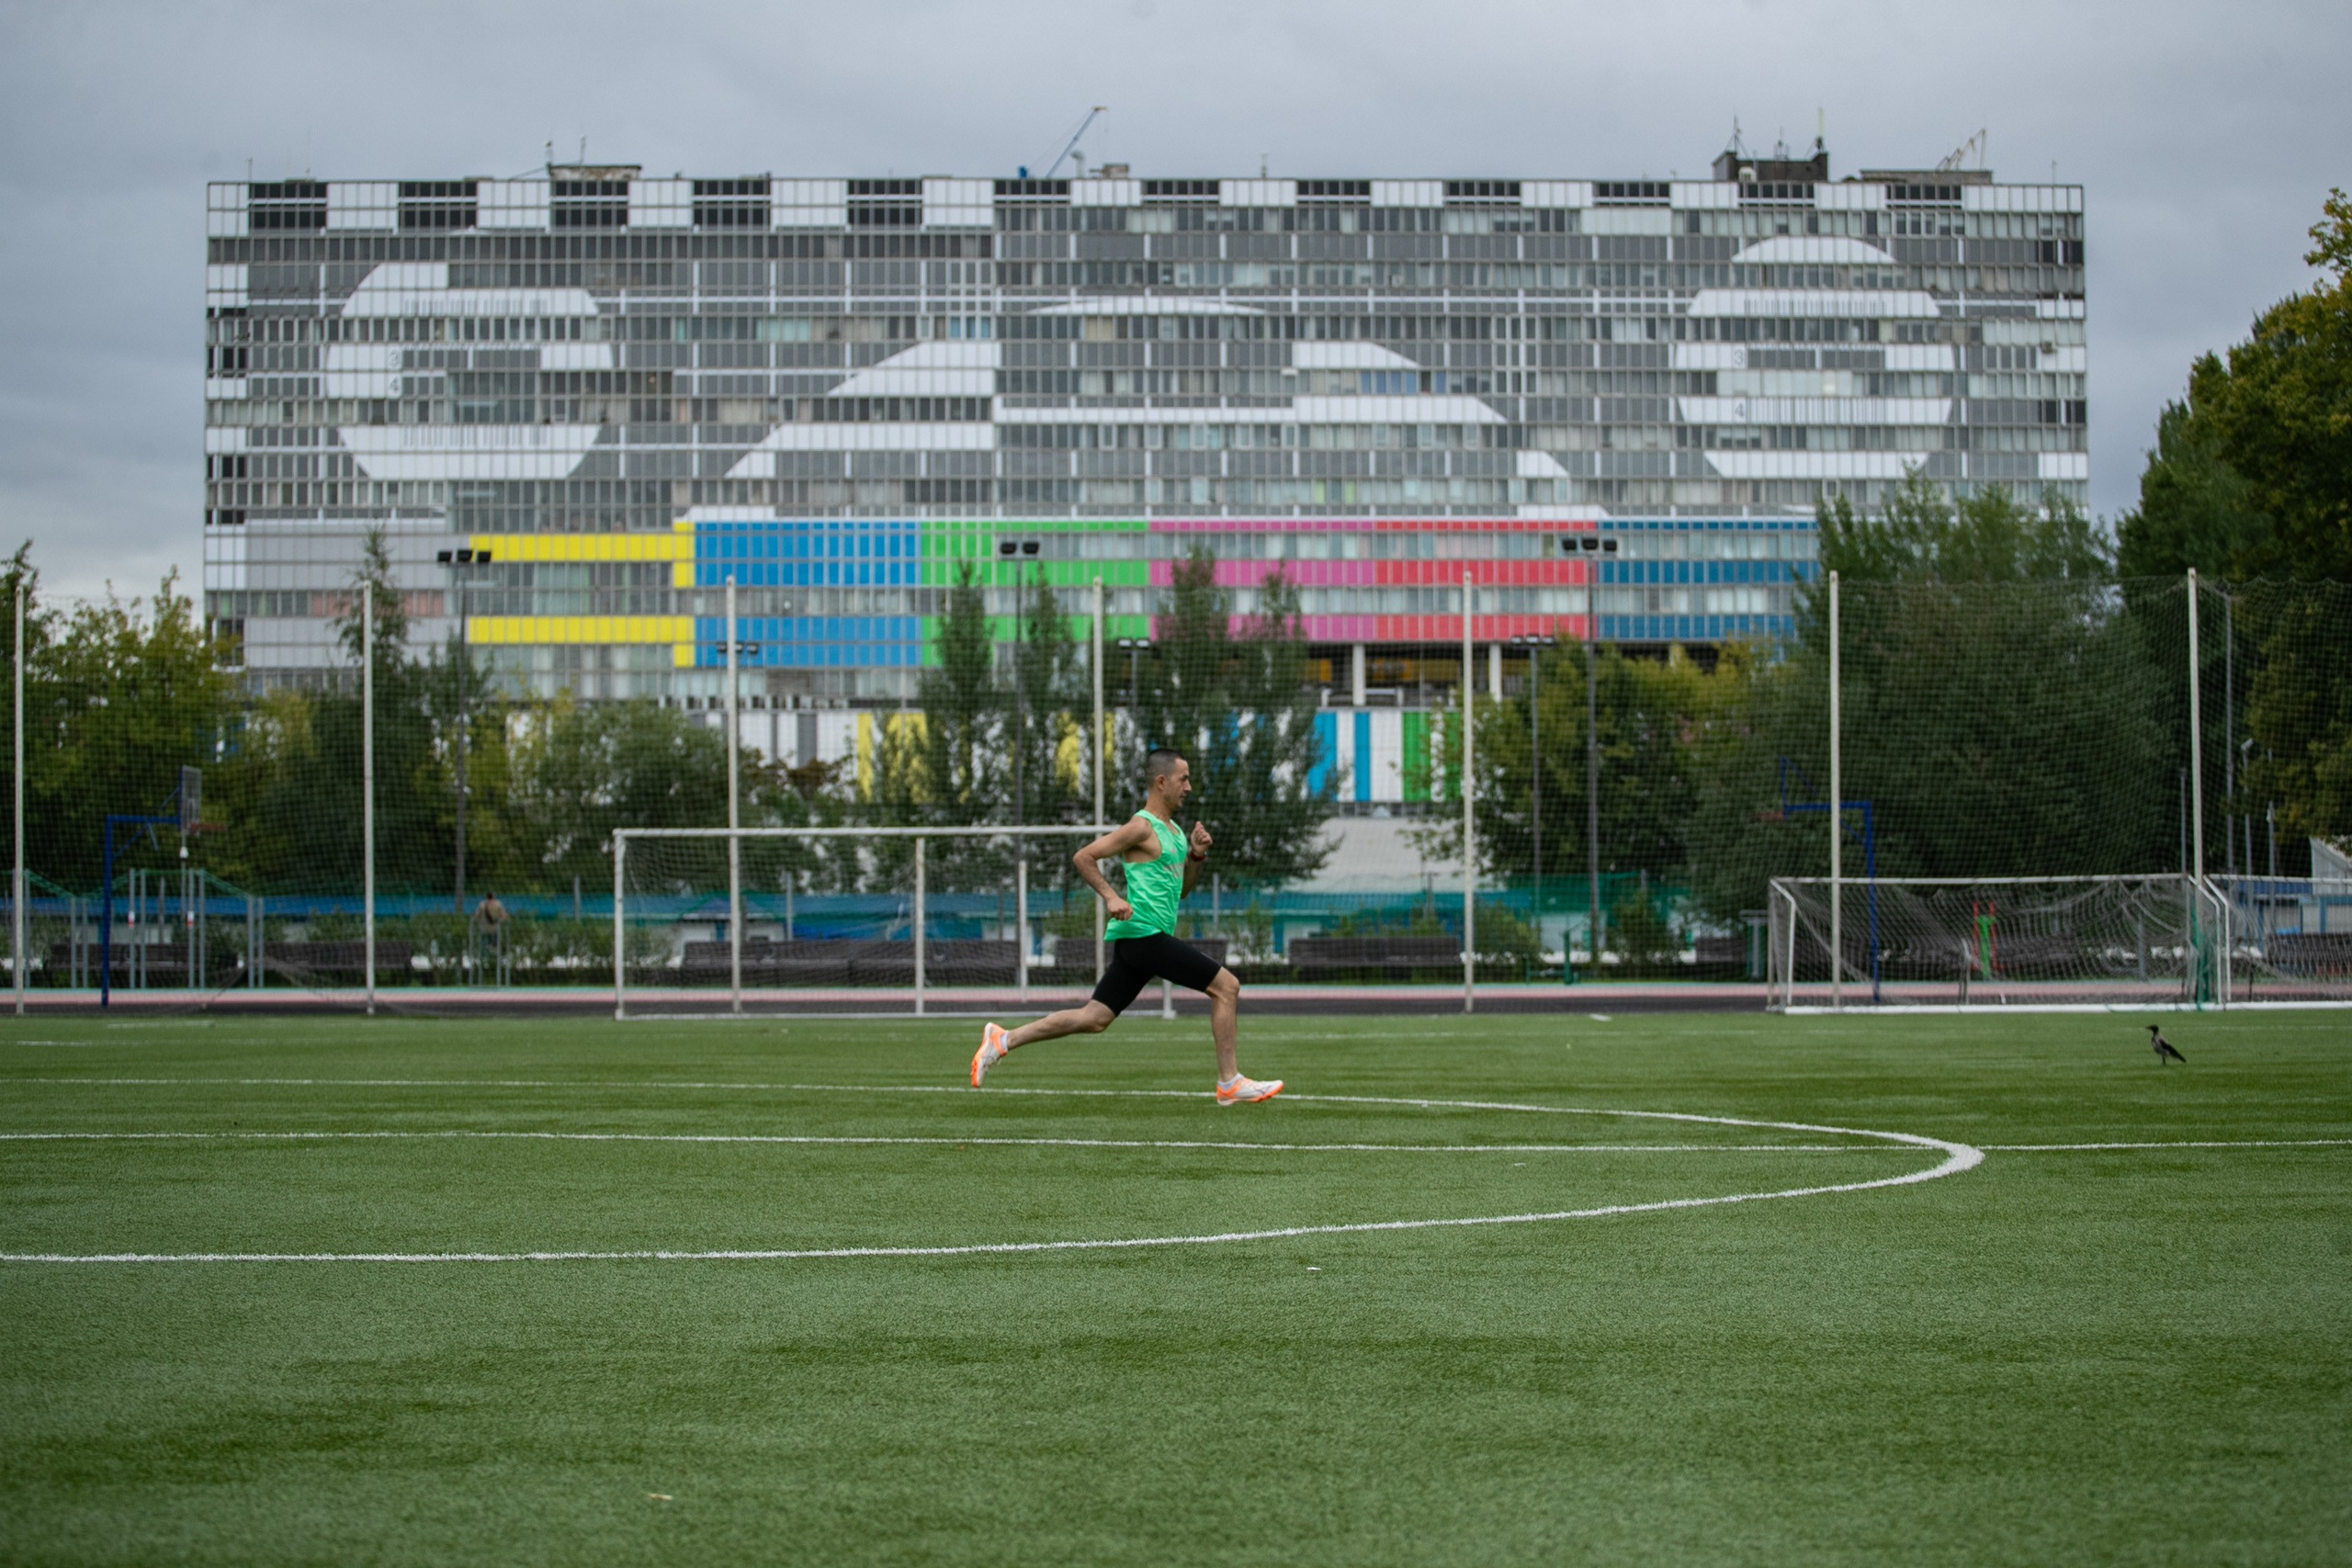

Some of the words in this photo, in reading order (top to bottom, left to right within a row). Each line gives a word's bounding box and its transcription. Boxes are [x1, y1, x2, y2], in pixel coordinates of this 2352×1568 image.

[1735, 349, 1744, 365] 3
[390, 378, 399, 393] 4
[1735, 402, 1745, 418] 4
